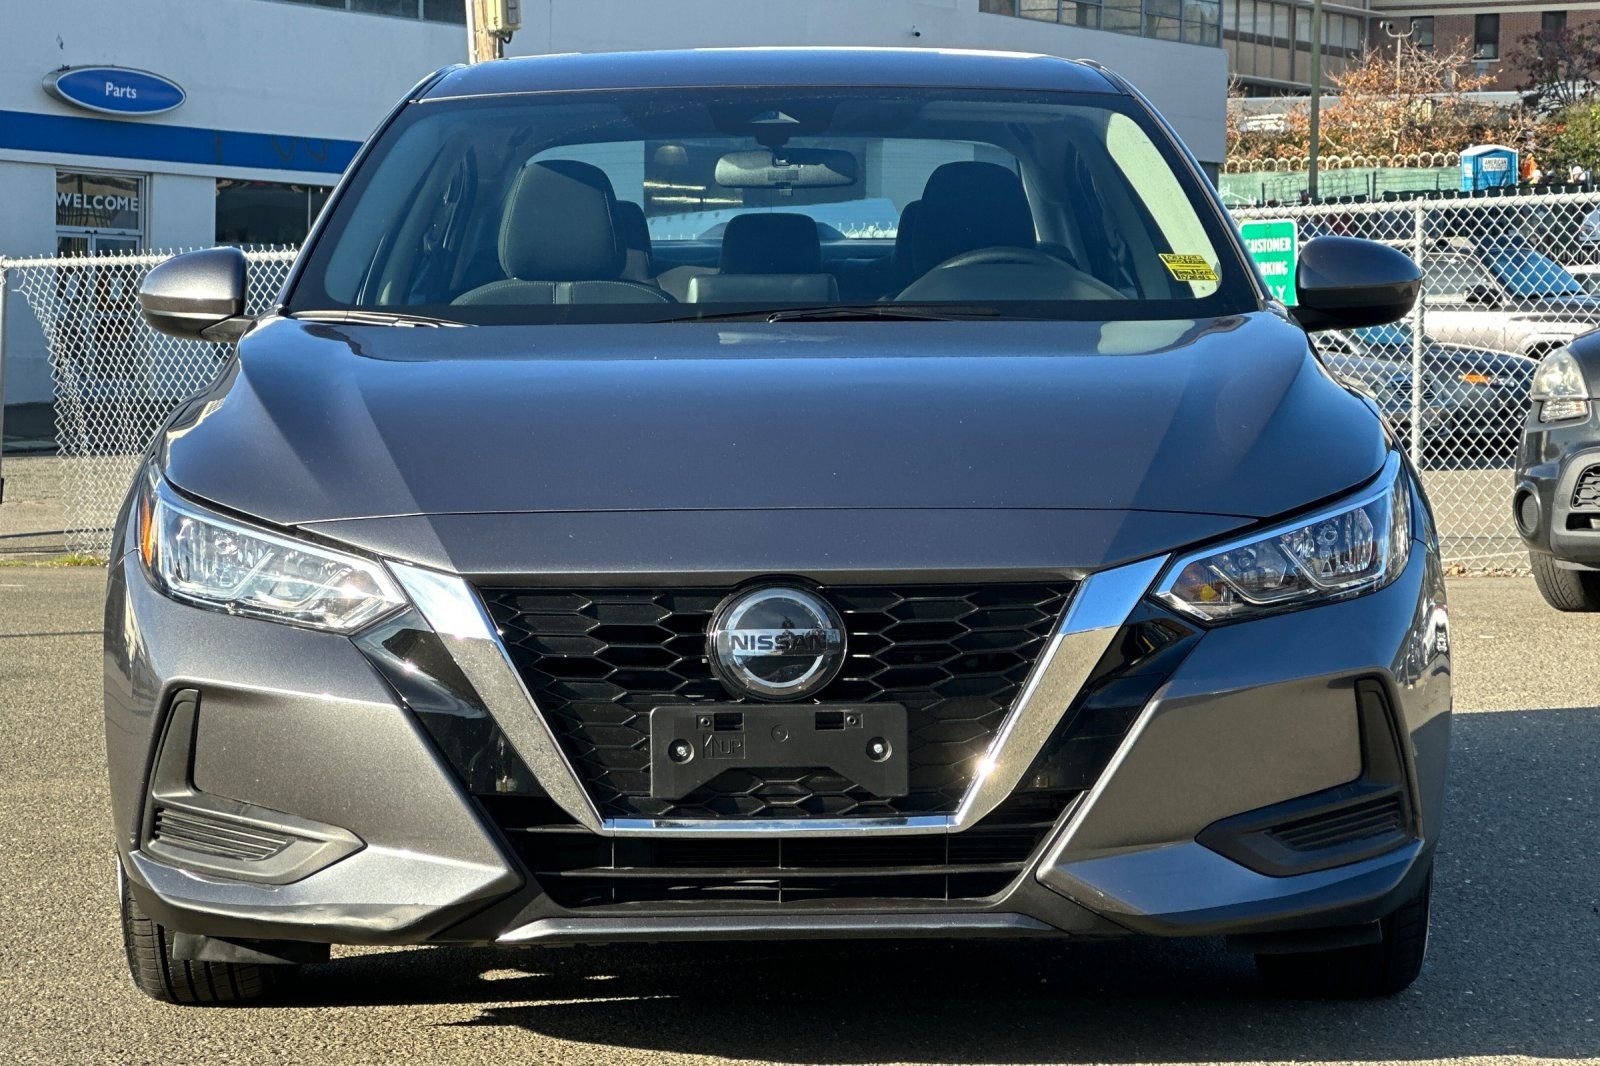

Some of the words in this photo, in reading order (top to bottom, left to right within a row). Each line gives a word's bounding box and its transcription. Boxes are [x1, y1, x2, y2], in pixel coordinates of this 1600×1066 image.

[105, 82, 137, 99] Parts
[56, 192, 139, 211] WELCOME
[730, 634, 827, 650] NISSAN
